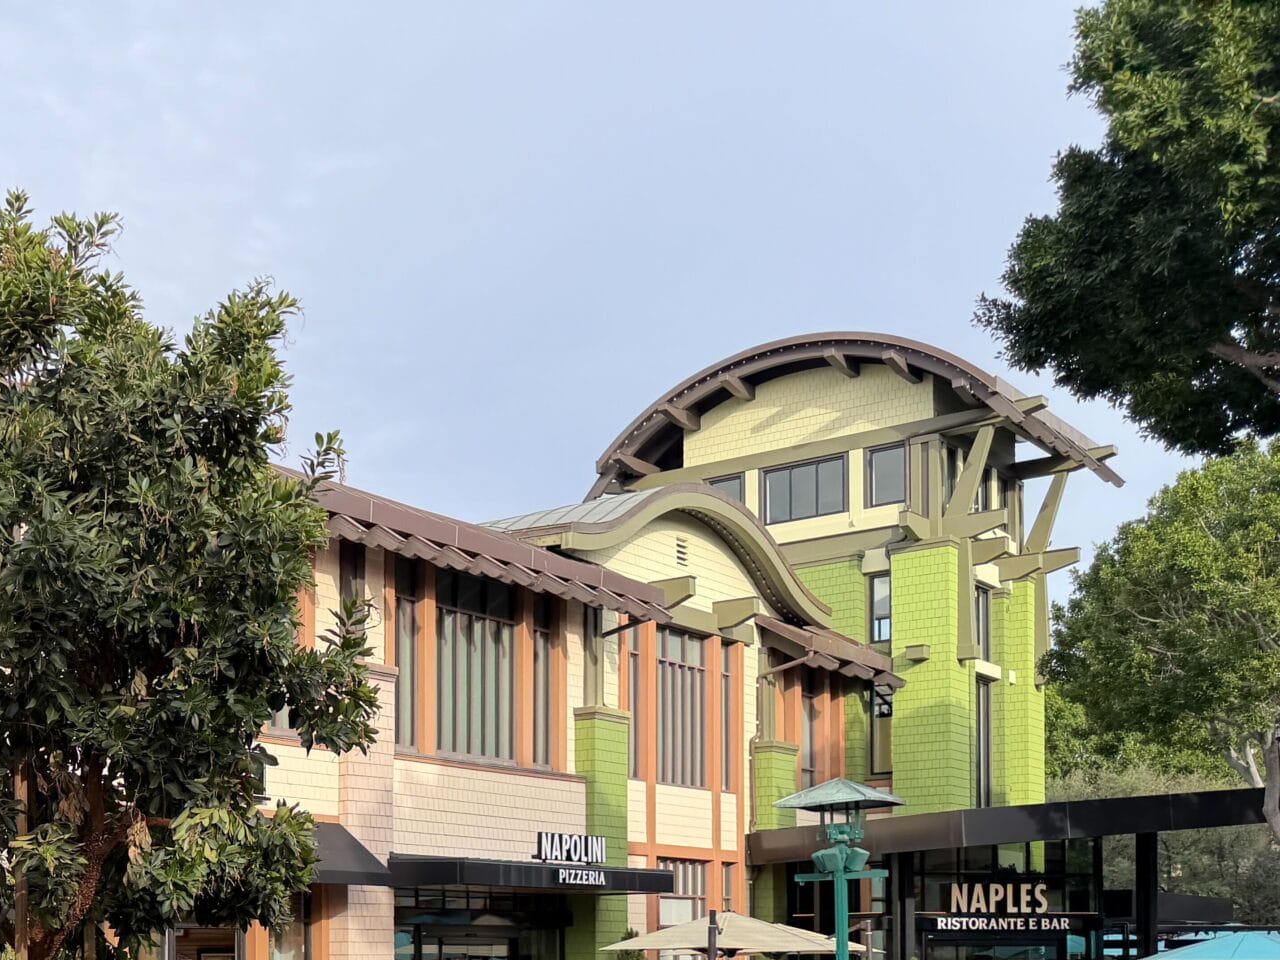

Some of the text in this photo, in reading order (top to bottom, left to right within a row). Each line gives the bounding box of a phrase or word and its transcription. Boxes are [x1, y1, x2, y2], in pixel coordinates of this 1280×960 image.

[540, 831, 606, 863] NAPOLINI
[558, 868, 606, 886] PIZZERIA
[950, 882, 1049, 914] NAPLES
[936, 917, 1070, 931] RISTORANTE E BAR
